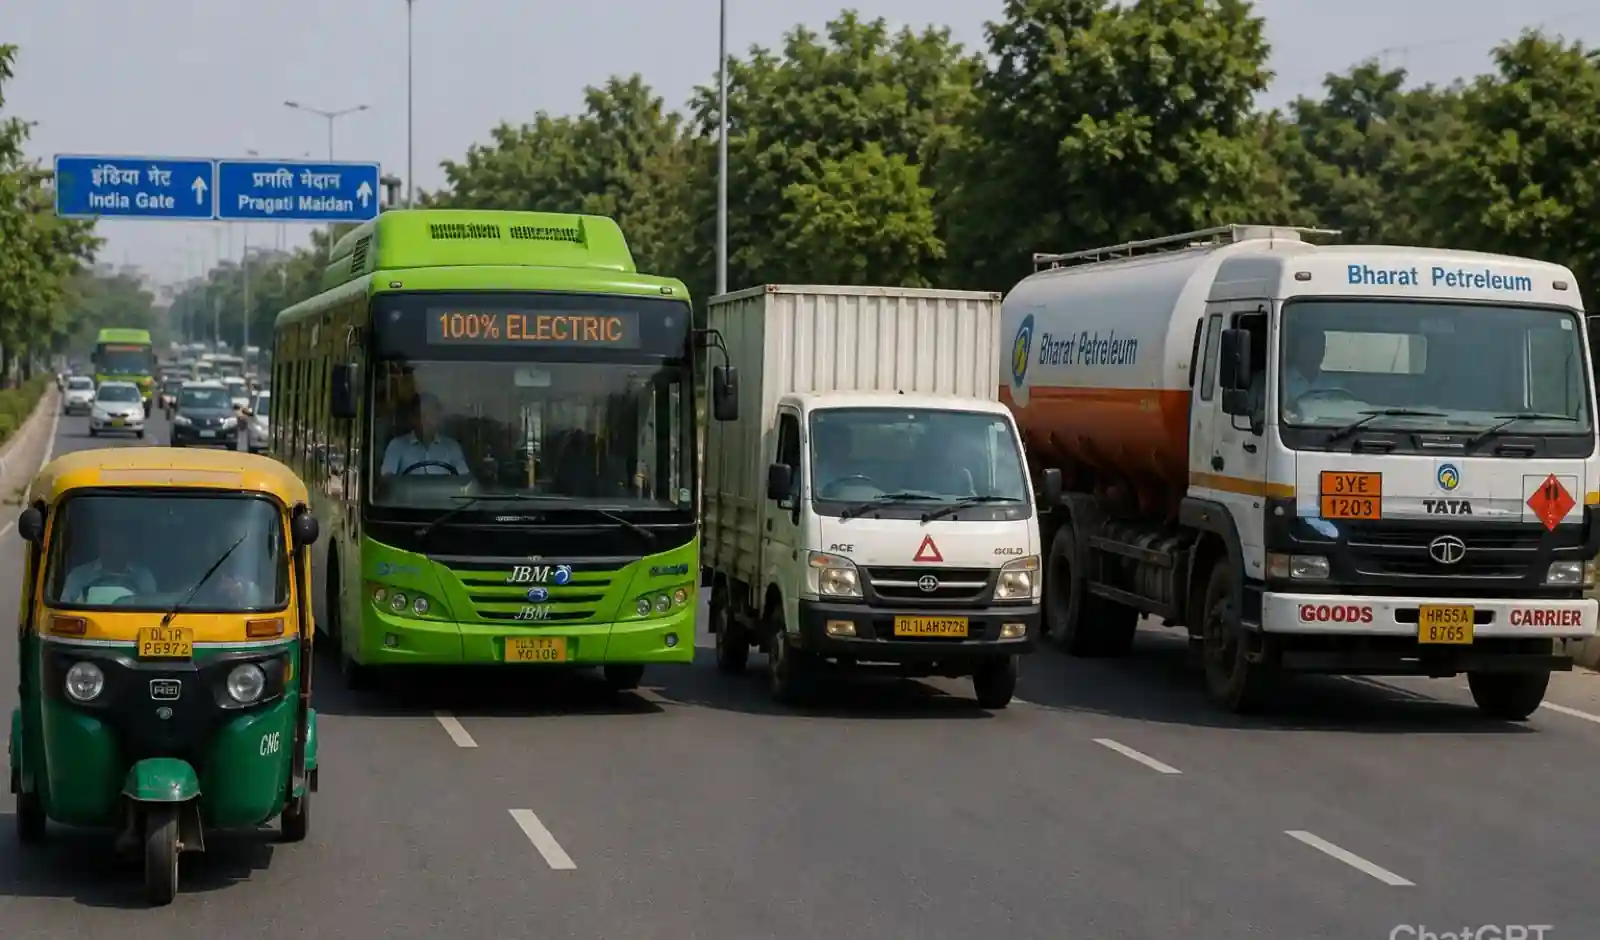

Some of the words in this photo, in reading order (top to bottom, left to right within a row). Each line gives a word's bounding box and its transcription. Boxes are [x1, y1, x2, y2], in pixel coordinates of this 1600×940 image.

[89, 191, 130, 209] India
[135, 192, 175, 209] Gate
[238, 194, 293, 214] Pragati
[299, 195, 354, 212] Maidan
[1347, 264, 1418, 285] Bharat
[439, 311, 499, 339] 100%
[506, 313, 623, 341] ELECTRIC
[1039, 331, 1077, 365] Bharat
[1335, 475, 1369, 493] 3YE
[1330, 499, 1373, 516] 1203
[1422, 499, 1473, 515] TATA
[829, 543, 854, 552] ACE
[504, 565, 551, 583] JBM
[1300, 603, 1374, 623] GOODS
[1426, 608, 1469, 623] HR55A
[1510, 608, 1582, 627] CARRIER
[1430, 626, 1464, 641] 8765
[259, 731, 280, 756] CNG
